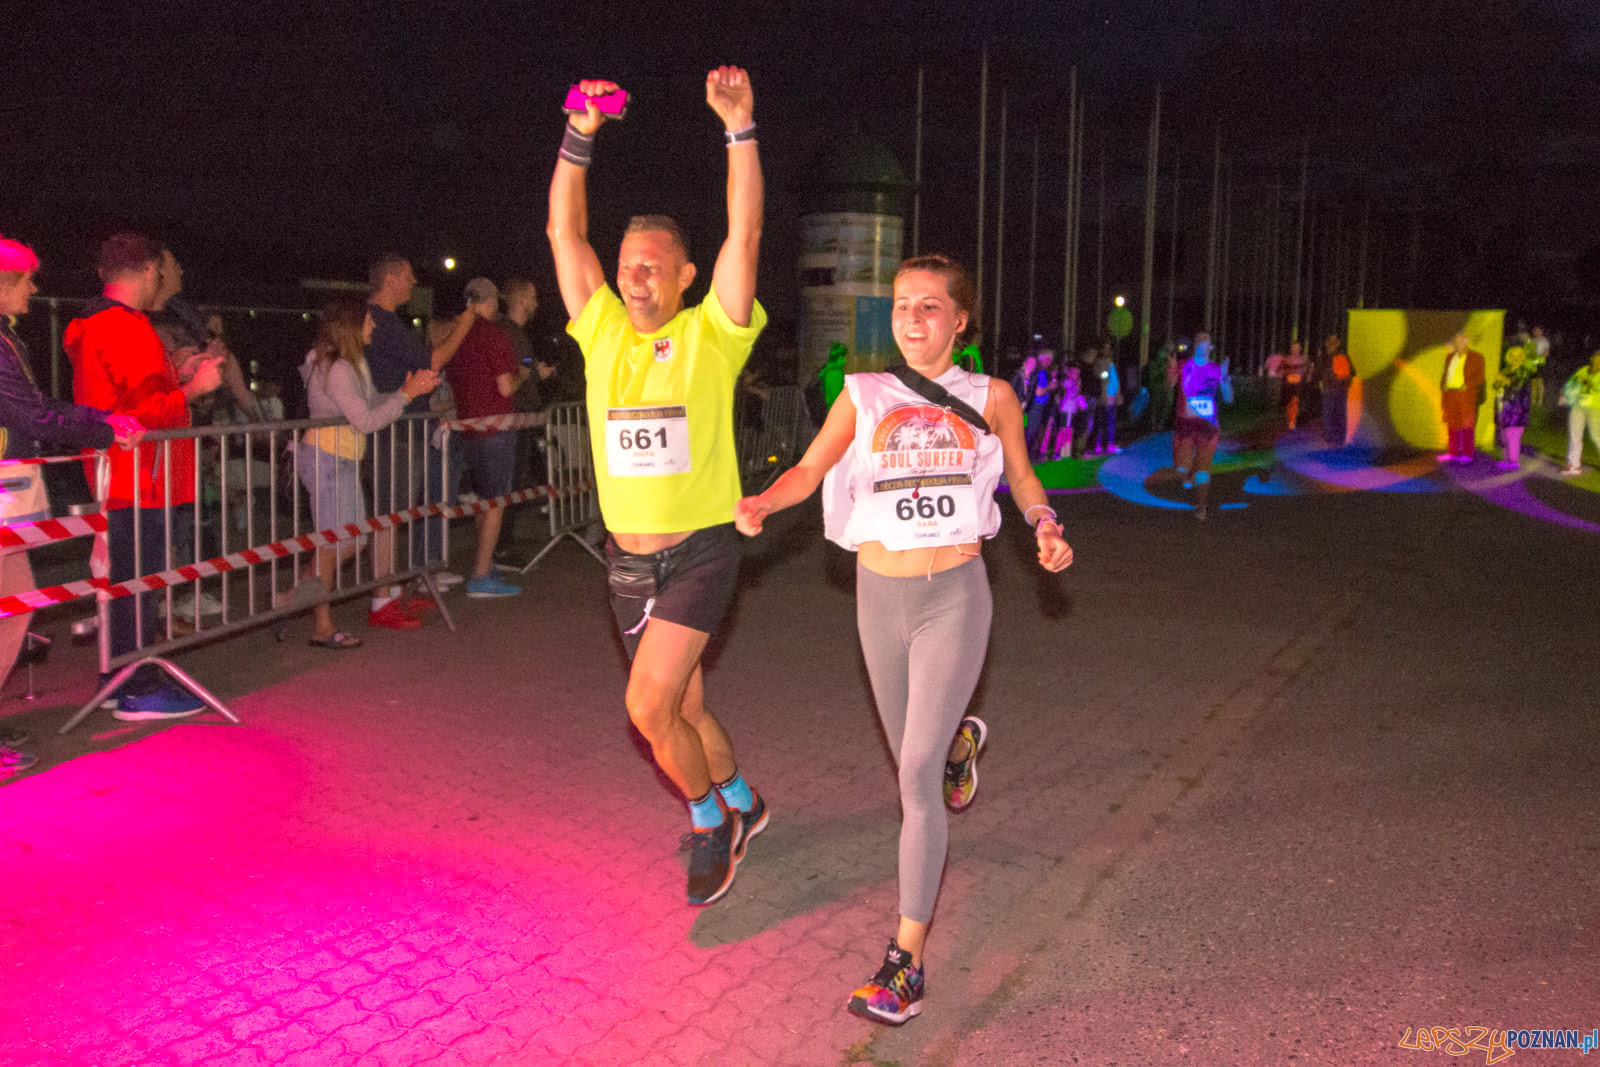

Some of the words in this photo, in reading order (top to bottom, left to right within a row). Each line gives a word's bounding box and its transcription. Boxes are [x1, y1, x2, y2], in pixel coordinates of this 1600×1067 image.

[619, 427, 667, 450] 661
[881, 453, 912, 468] SOUL
[917, 451, 964, 467] SURFER
[895, 495, 955, 520] 660
